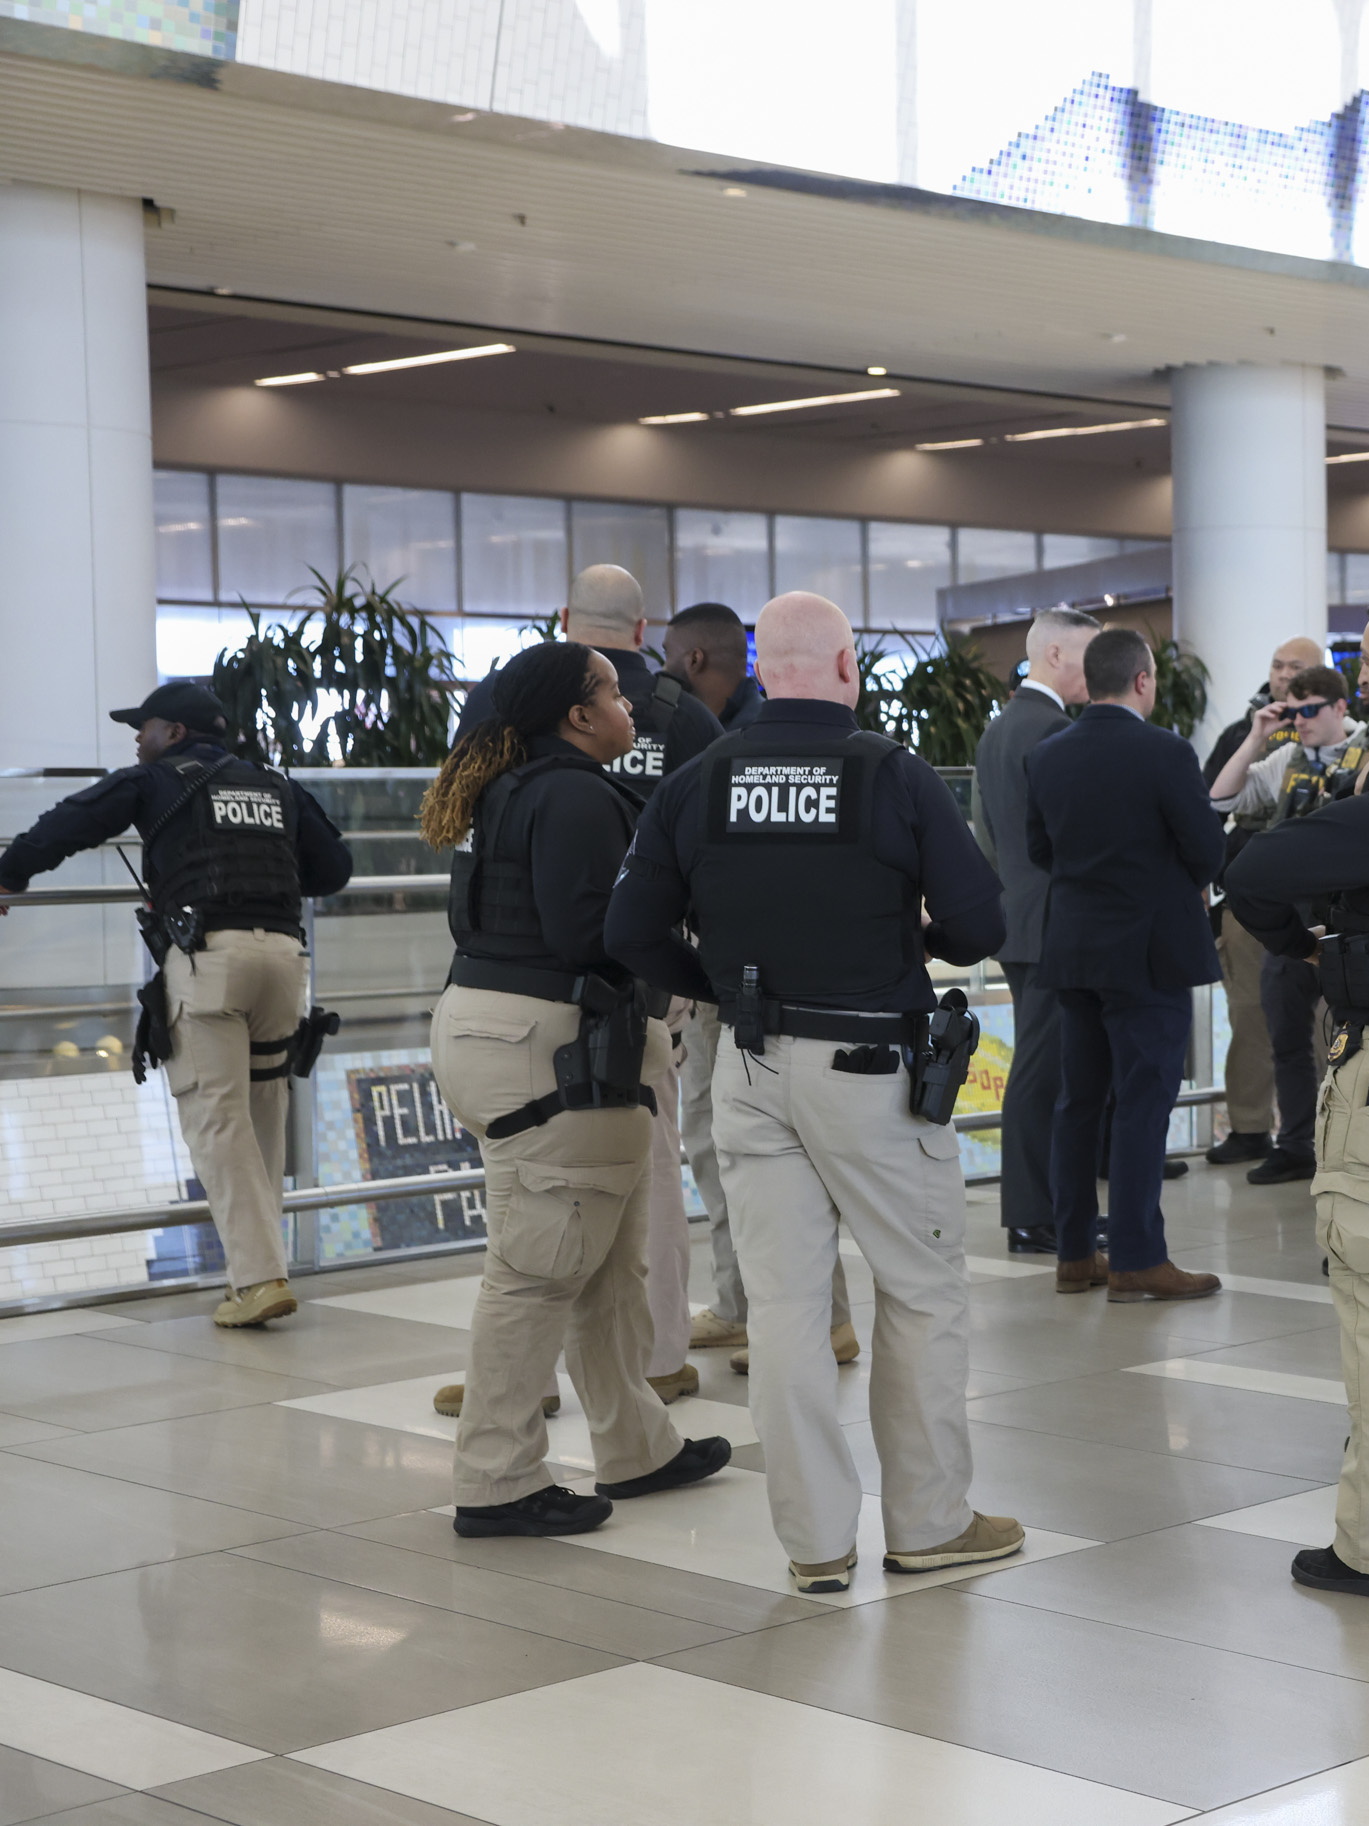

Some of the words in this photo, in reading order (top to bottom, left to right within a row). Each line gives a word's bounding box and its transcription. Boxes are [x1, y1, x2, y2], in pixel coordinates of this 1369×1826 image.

[633, 742, 665, 751] URITY
[637, 736, 652, 744] OF
[602, 749, 664, 776] ICE
[745, 766, 811, 775] DEPARTMENT
[812, 766, 827, 775] OF
[731, 775, 786, 784] HOMELAND
[788, 775, 839, 784] SECURITY
[729, 785, 838, 823] POLICE
[212, 801, 284, 829] POLICE
[371, 1080, 464, 1147] PELH
